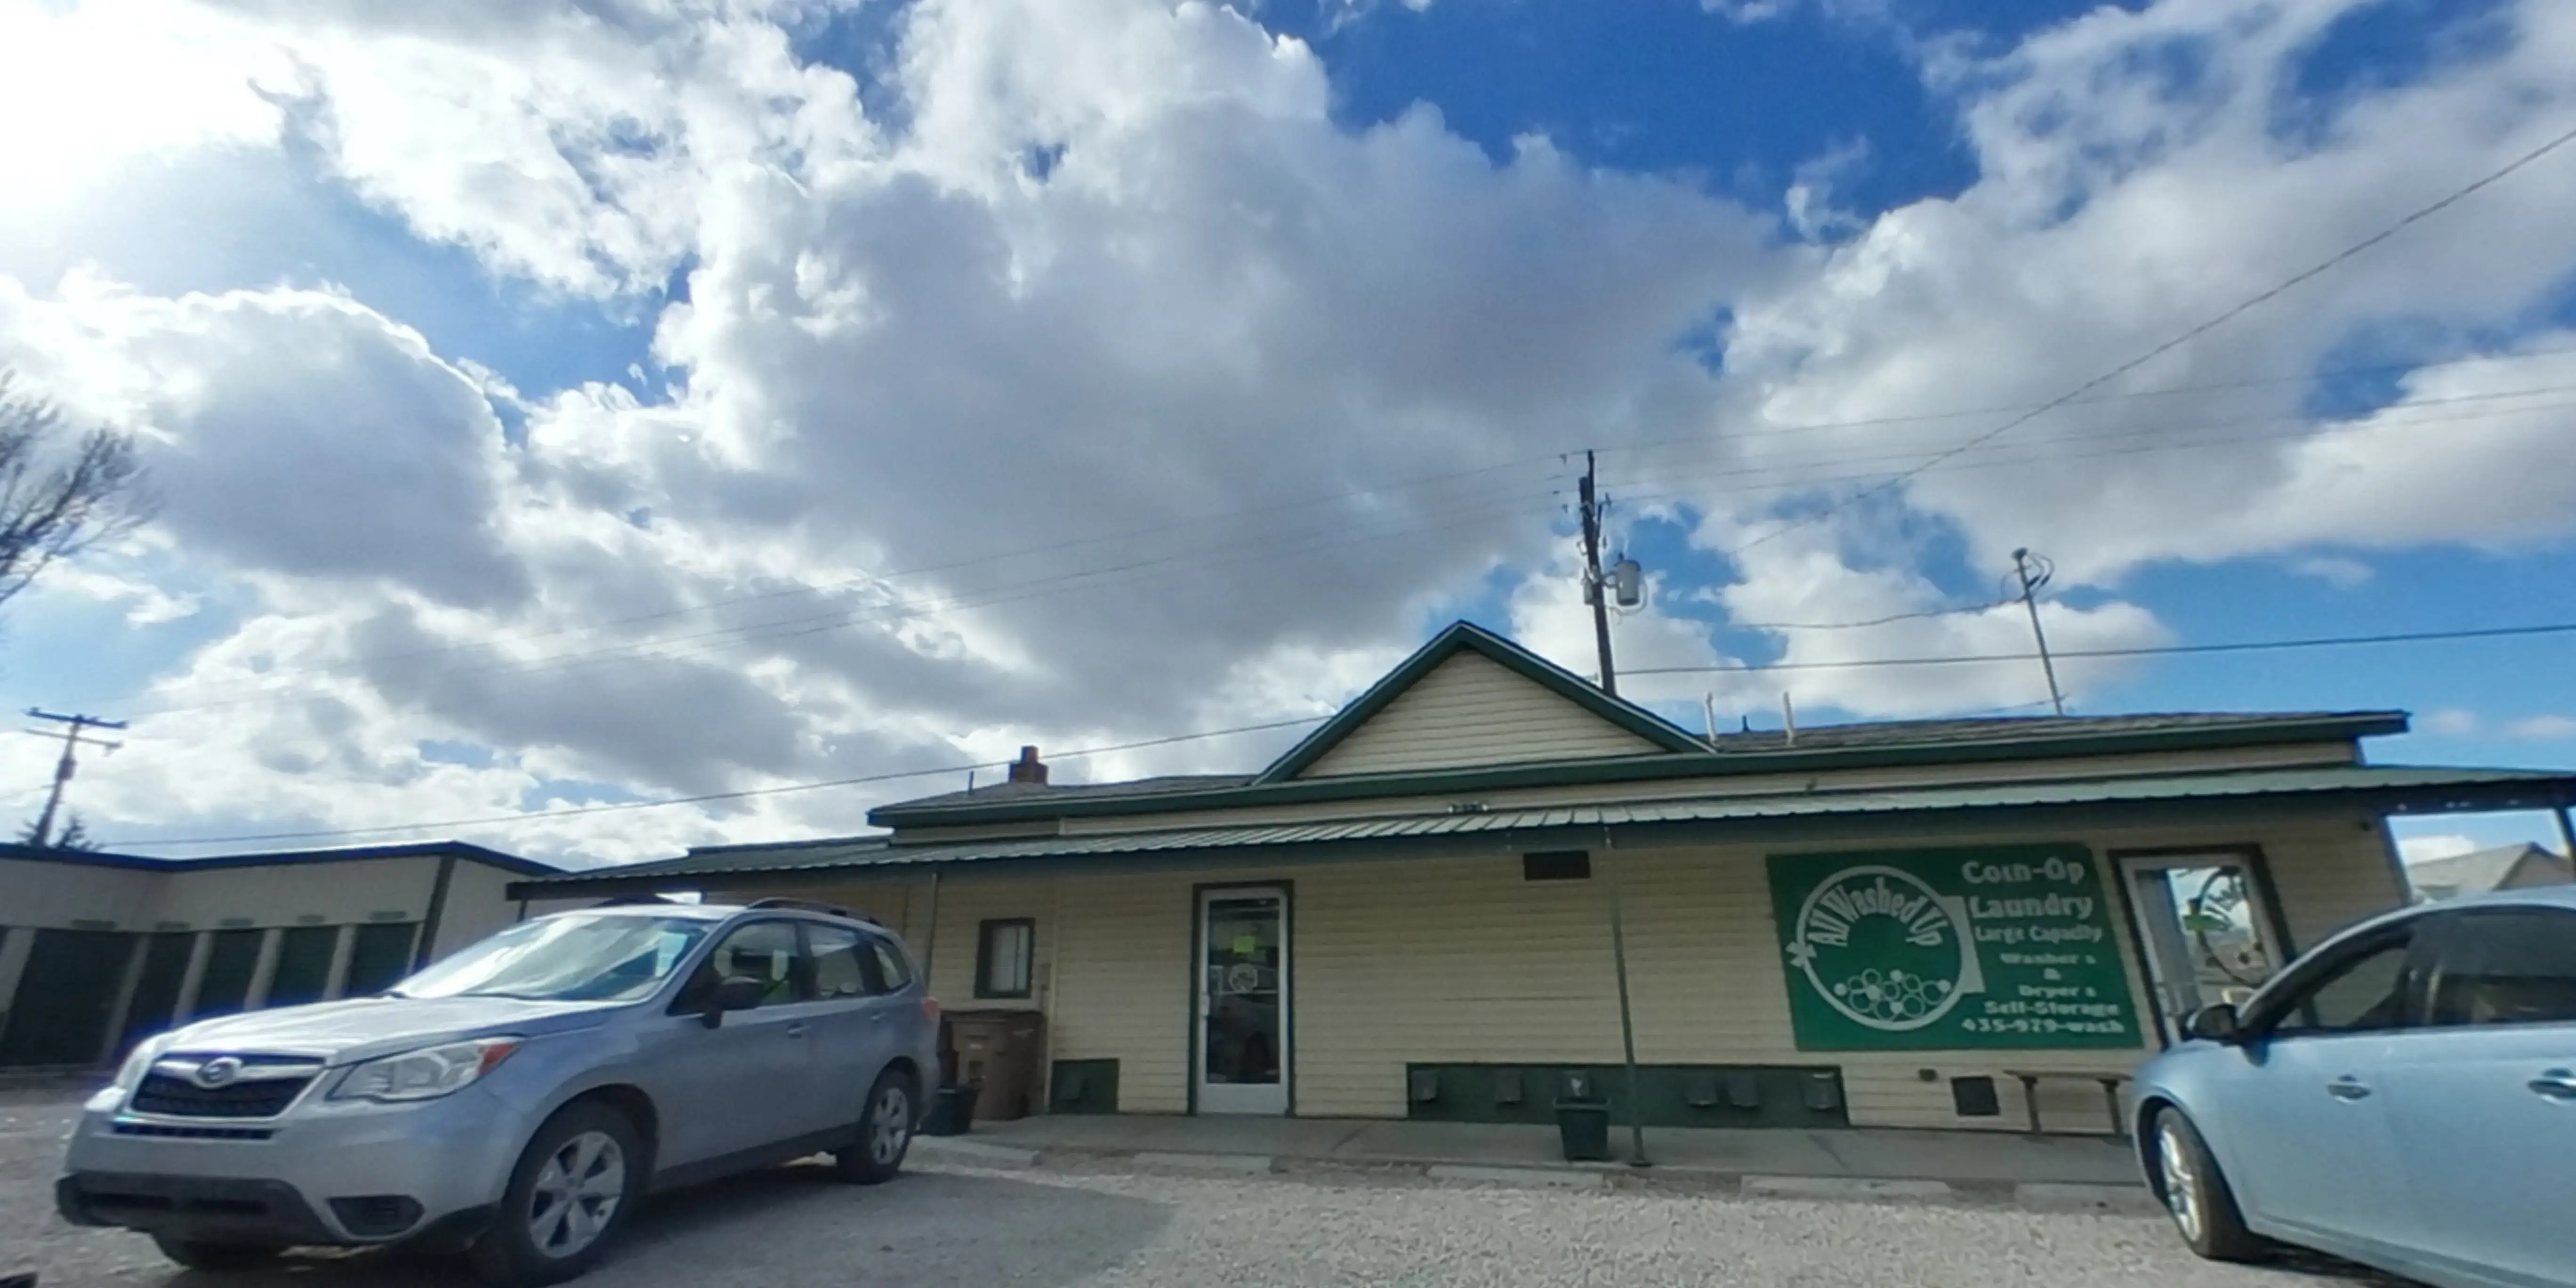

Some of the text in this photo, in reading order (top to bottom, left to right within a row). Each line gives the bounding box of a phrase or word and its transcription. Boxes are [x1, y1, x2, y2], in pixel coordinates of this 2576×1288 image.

[1961, 856, 2085, 885] Coin-Op
[1807, 876, 1949, 948] All Washed Up
[1969, 892, 2093, 920] Laundry
[1975, 924, 2103, 945] Large Capacity
[1983, 1000, 2120, 1017] Self-Storage
